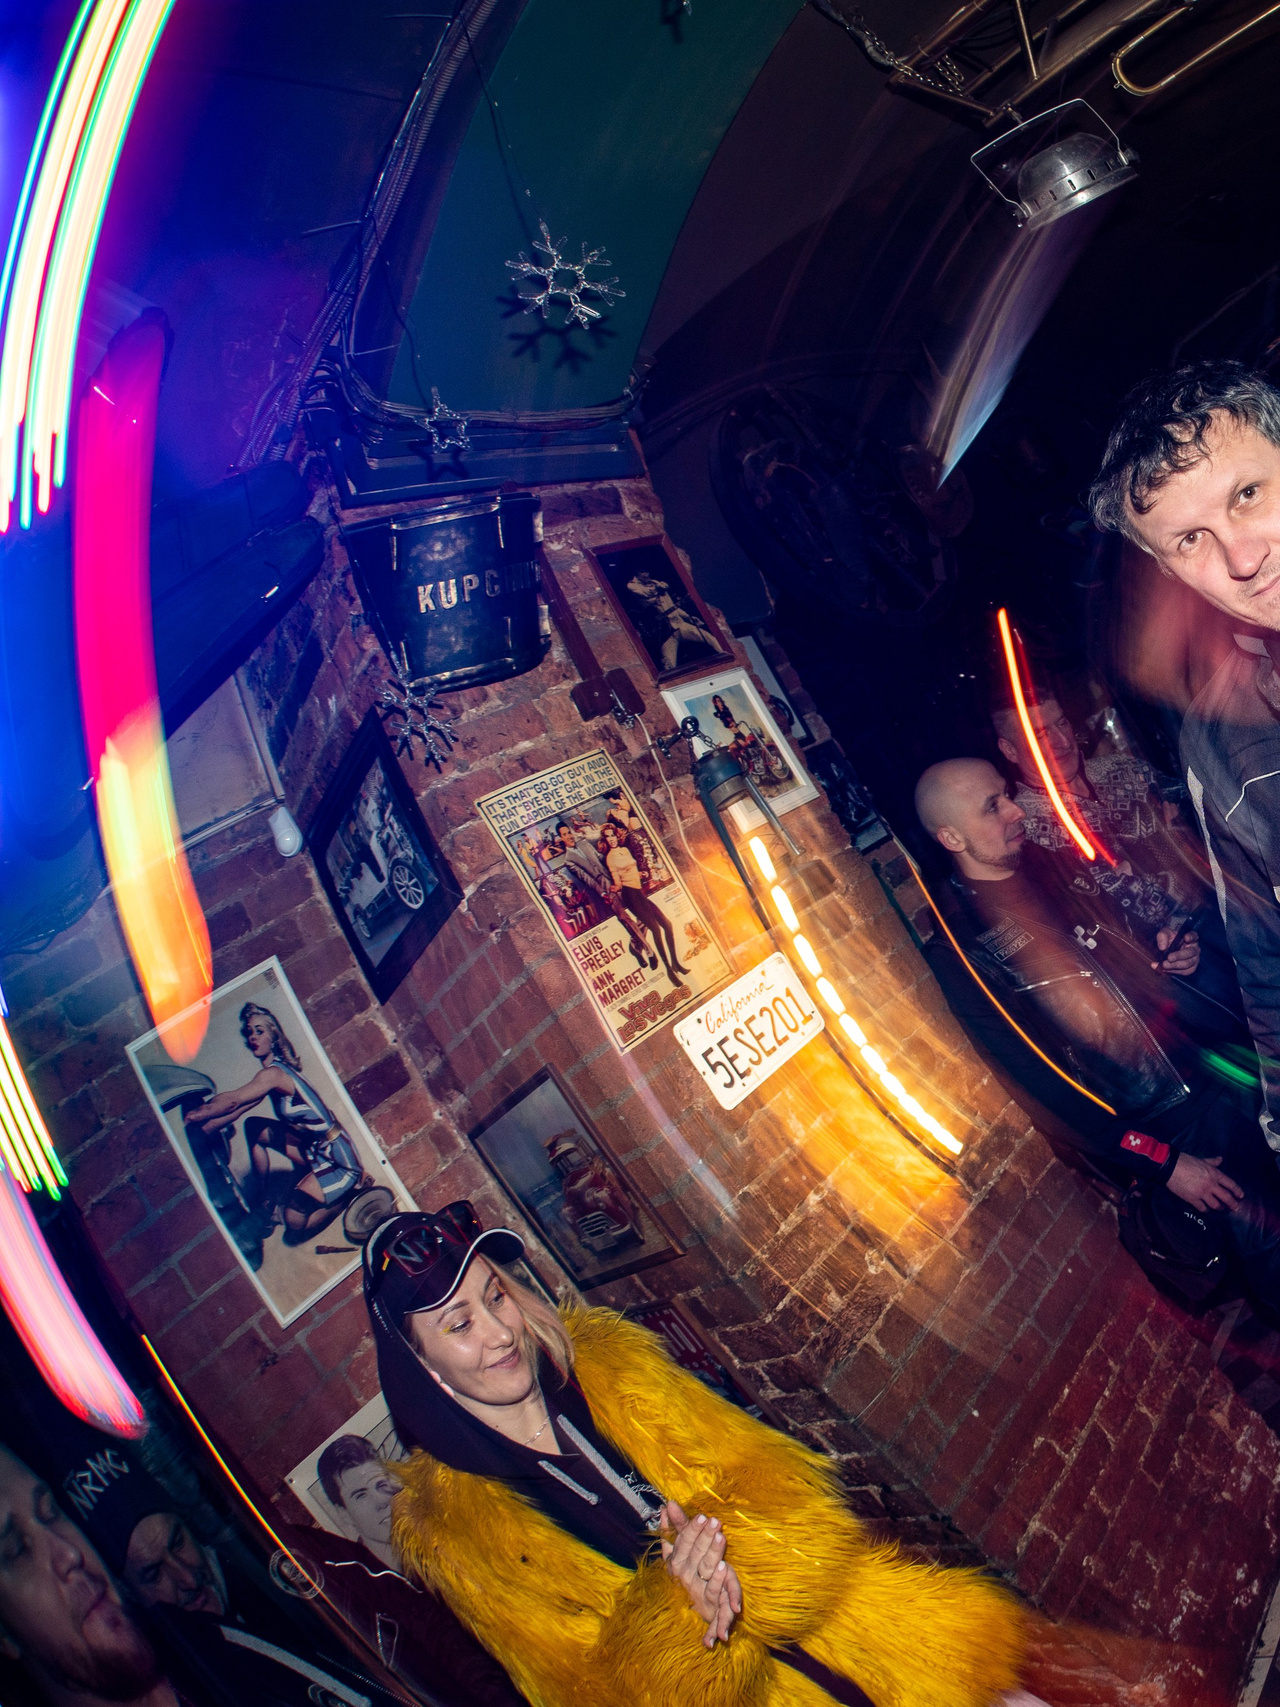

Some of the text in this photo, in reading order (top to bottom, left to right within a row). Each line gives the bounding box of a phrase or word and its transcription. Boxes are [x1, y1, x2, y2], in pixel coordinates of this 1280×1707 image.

[485, 798, 506, 815] IT'S
[504, 787, 532, 807] THAT
[567, 764, 588, 780] GUY
[587, 756, 608, 771] AND
[492, 807, 520, 825] THAT
[563, 780, 584, 796] GAL
[583, 774, 595, 785] IN
[594, 766, 614, 780] THE
[498, 776, 620, 836] FUN CAPITAL OF THE WORLD!
[572, 935, 603, 963] ELVIS
[580, 940, 626, 976] PRESLEY
[591, 969, 615, 993] ANN-
[598, 967, 646, 1008] MARGRET
[705, 982, 774, 1034] California
[701, 987, 813, 1089] 5ESE201
[66, 1448, 130, 1520] NRMC
